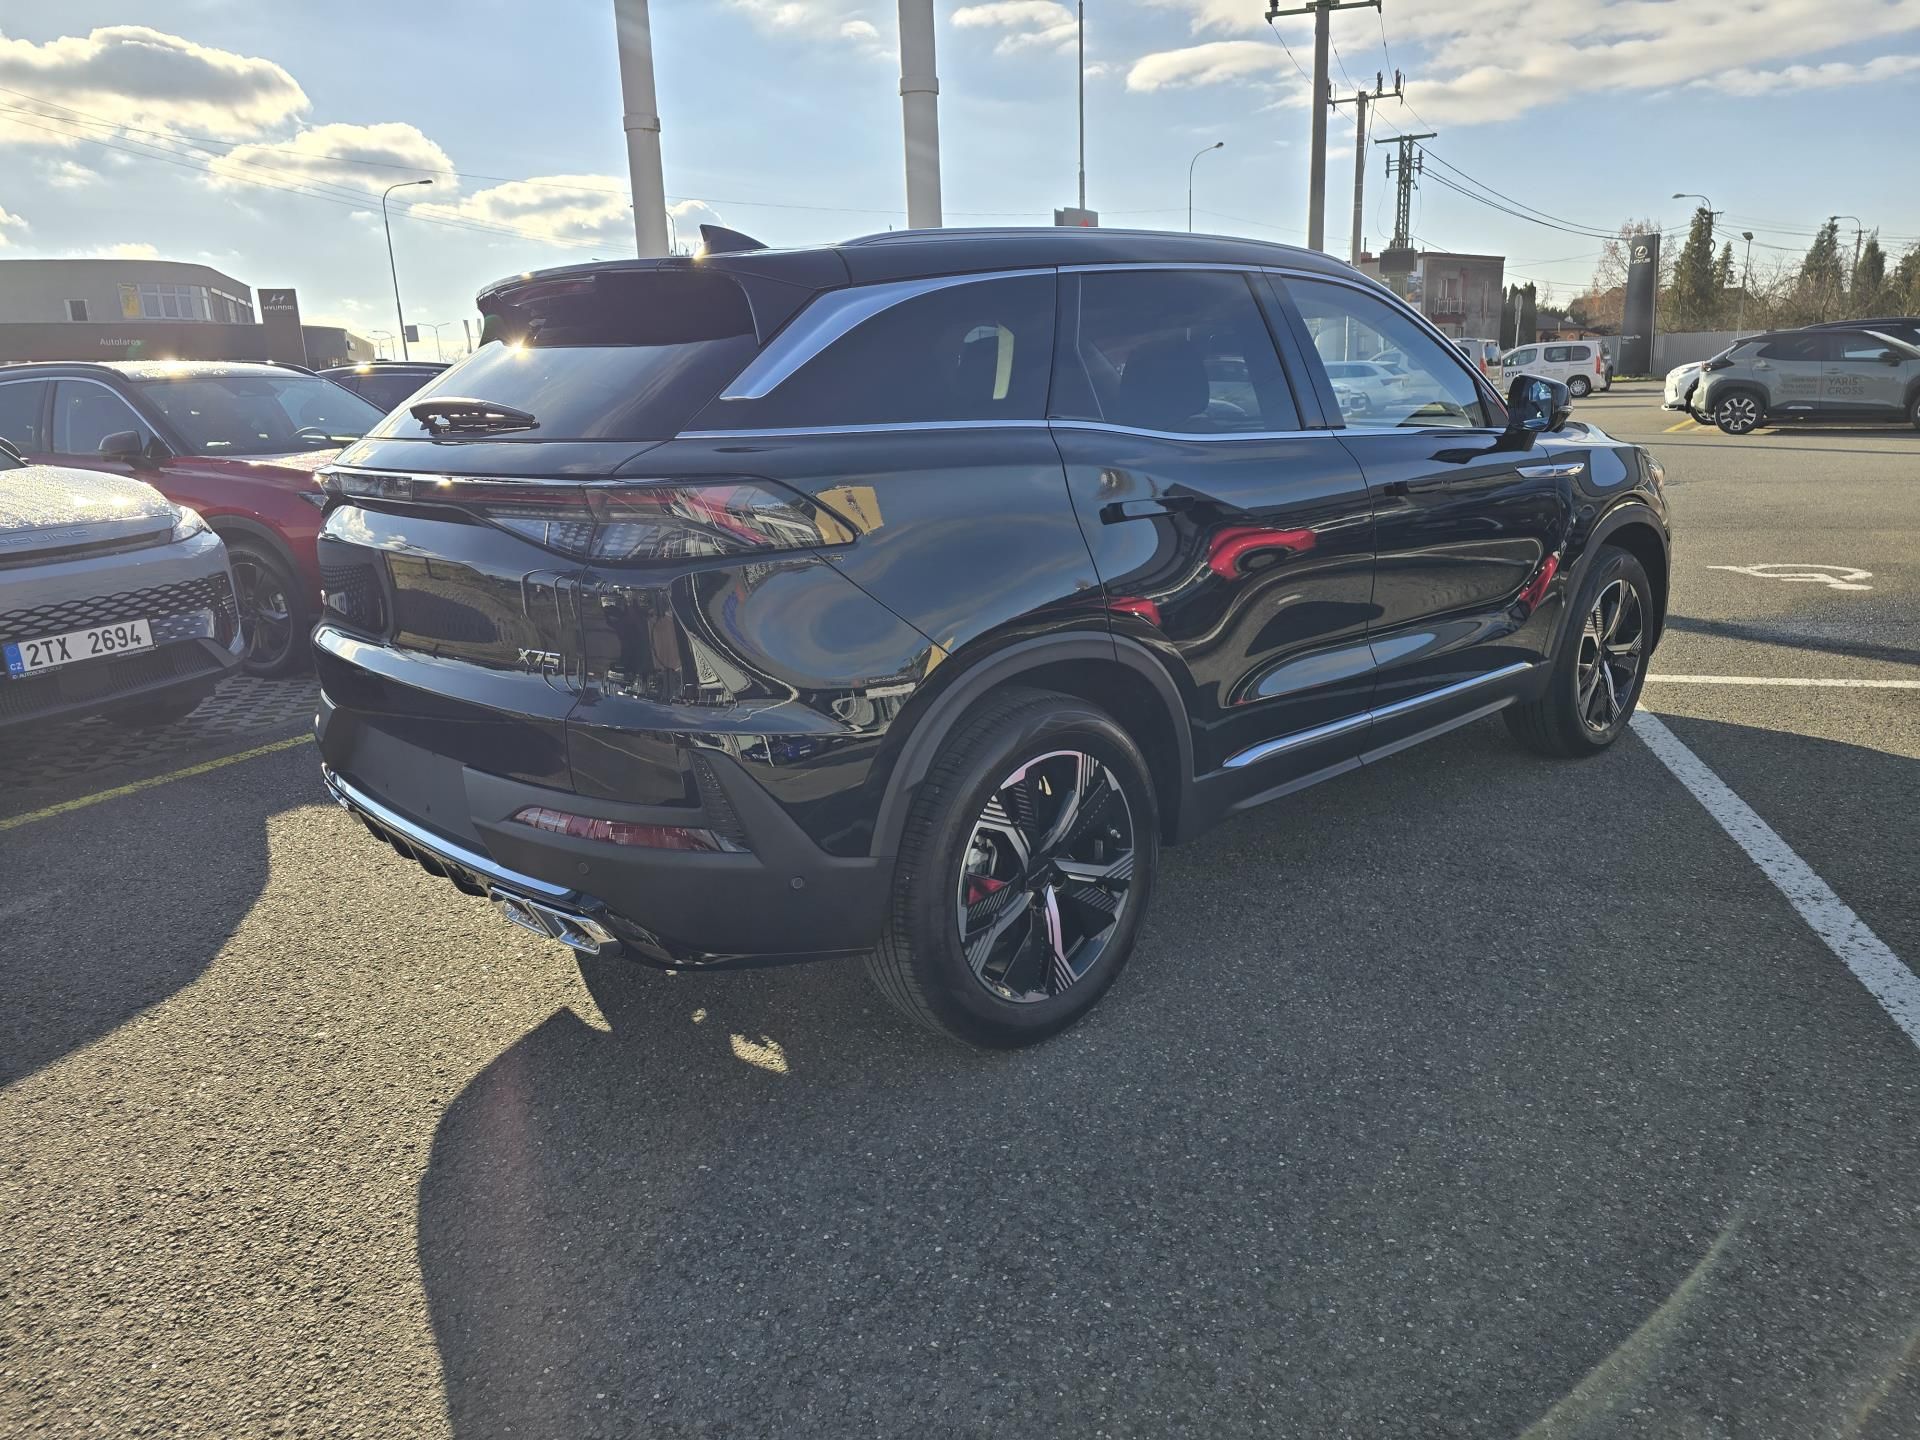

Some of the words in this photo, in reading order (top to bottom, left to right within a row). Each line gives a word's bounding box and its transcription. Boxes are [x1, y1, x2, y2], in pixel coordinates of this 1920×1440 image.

[263, 304, 295, 312] HYUNDAI
[1827, 376, 1859, 386] YARIS
[1826, 386, 1865, 396] CROSS
[26, 636, 72, 667] 2TX
[87, 623, 142, 655] 2694
[514, 647, 561, 669] X75
[9, 662, 23, 671] CZ
